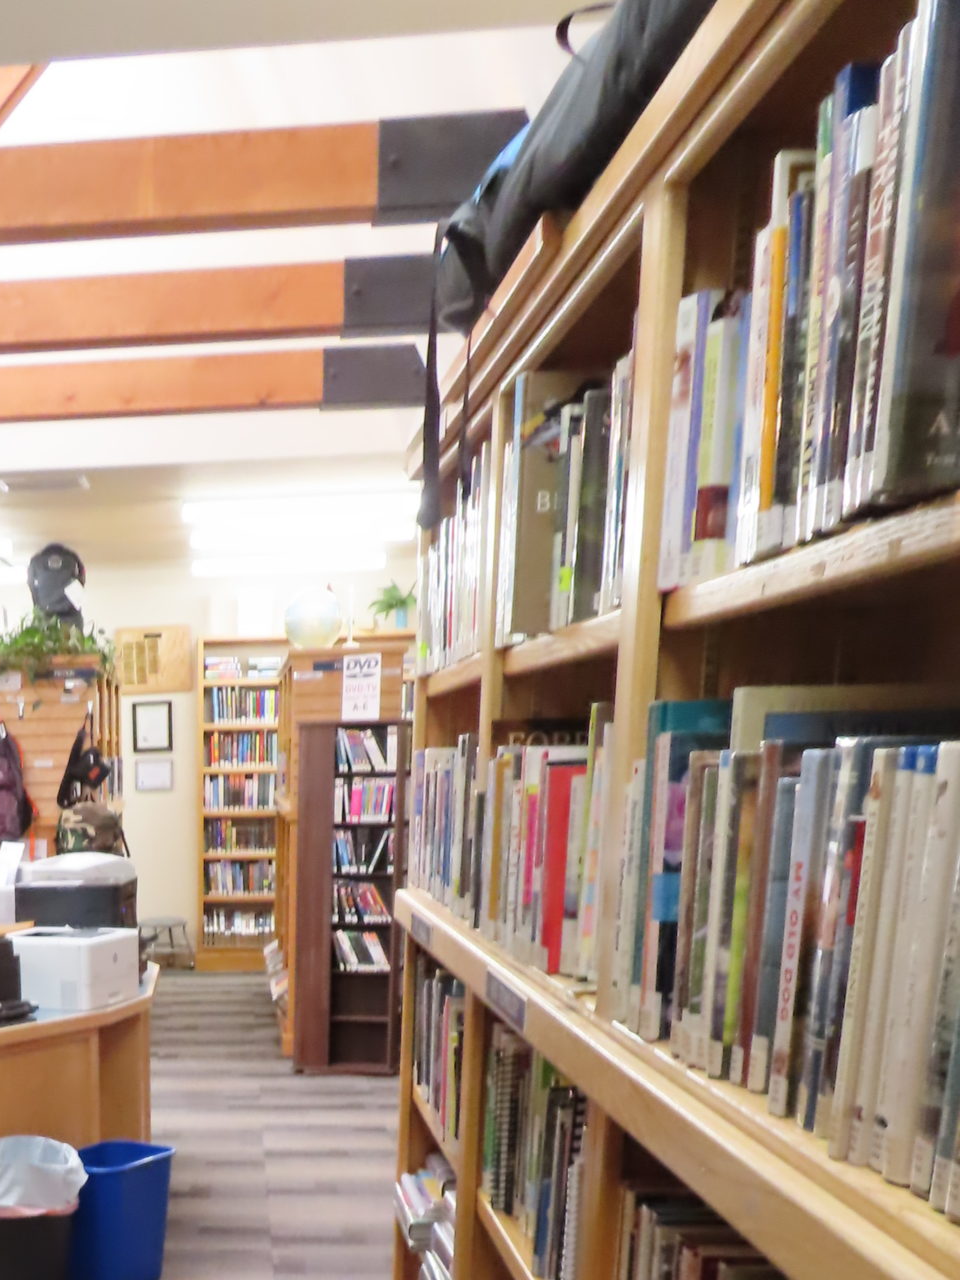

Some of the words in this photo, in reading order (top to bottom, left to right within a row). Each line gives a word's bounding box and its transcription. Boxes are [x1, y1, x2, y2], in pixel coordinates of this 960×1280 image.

[345, 657, 380, 673] DVD
[791, 861, 802, 898] MY
[785, 910, 798, 959] OLD
[779, 968, 792, 1022] DOG
